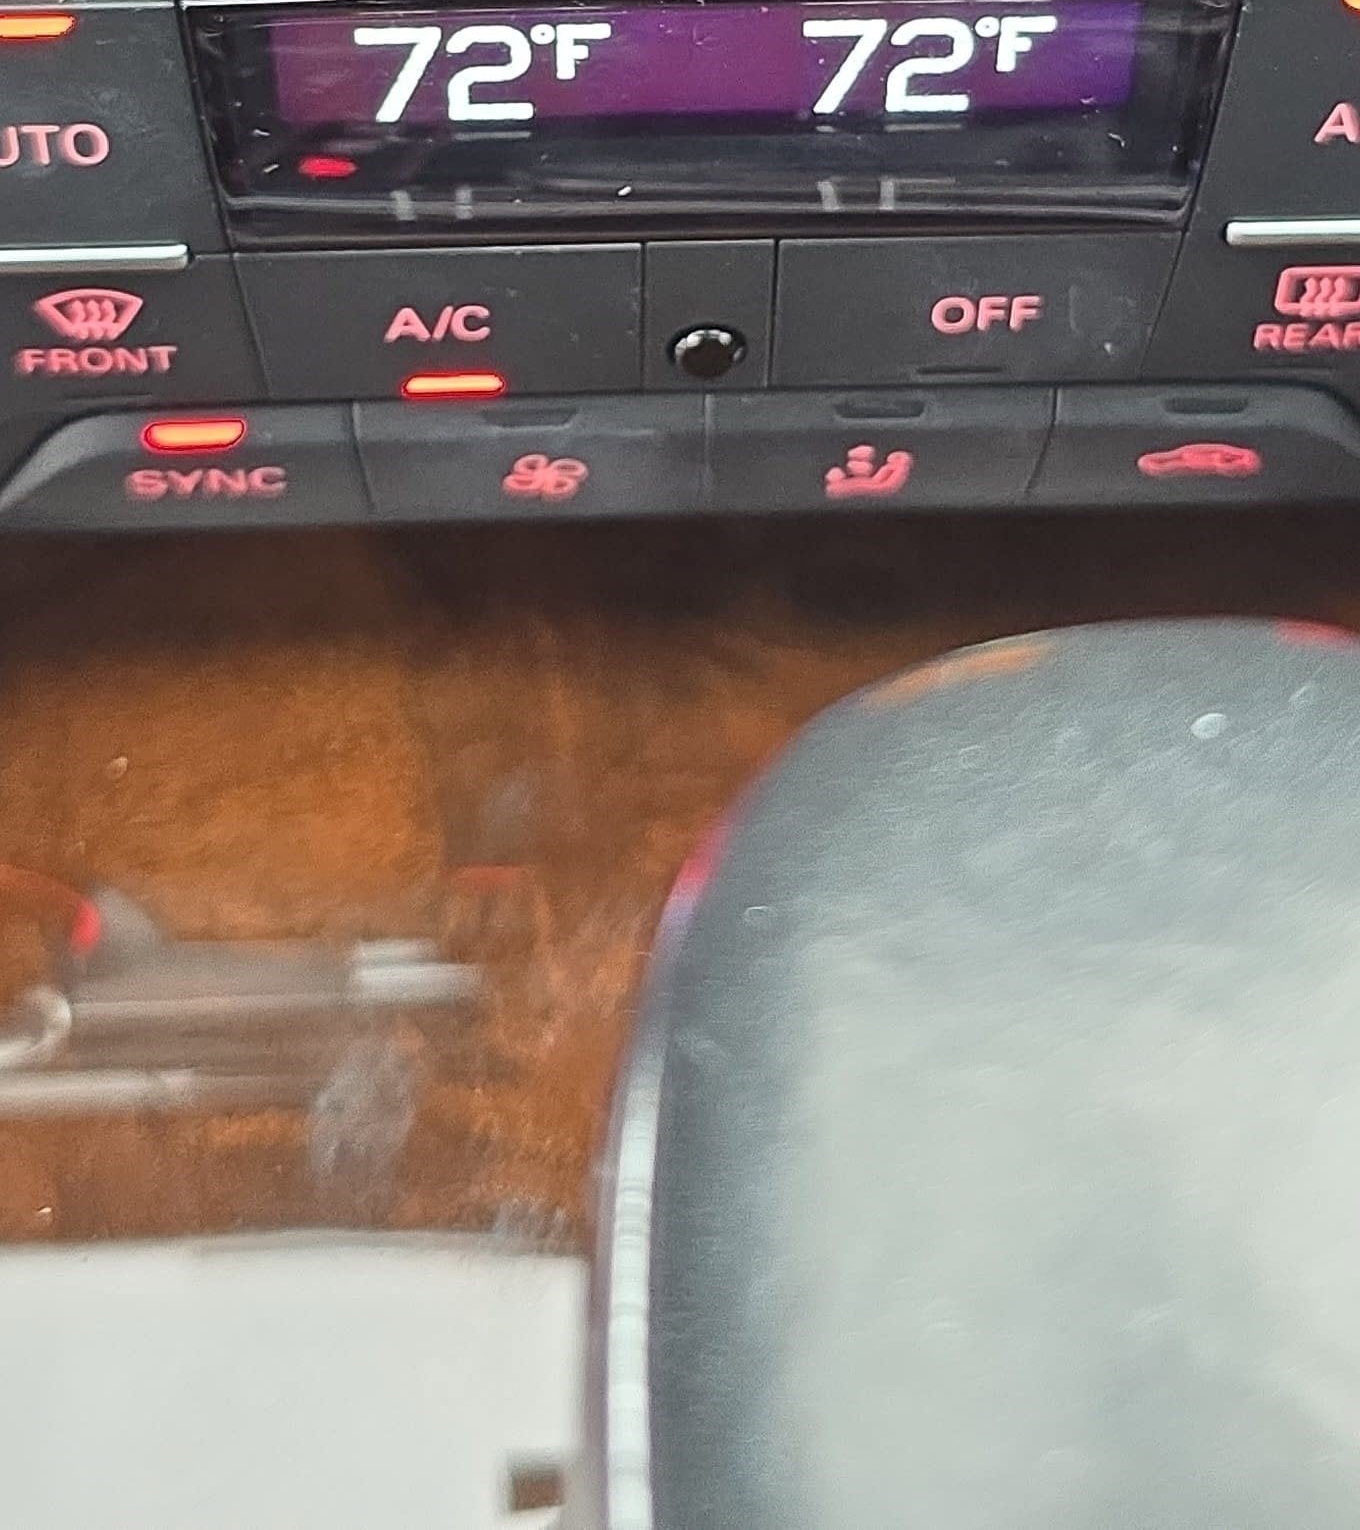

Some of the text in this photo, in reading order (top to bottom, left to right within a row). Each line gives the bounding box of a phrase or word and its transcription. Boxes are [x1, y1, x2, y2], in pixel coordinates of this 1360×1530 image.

[383, 303, 493, 343] A/C
[930, 294, 1043, 334] OFF
[15, 343, 179, 374] FRONT
[125, 467, 288, 499] SYNC
